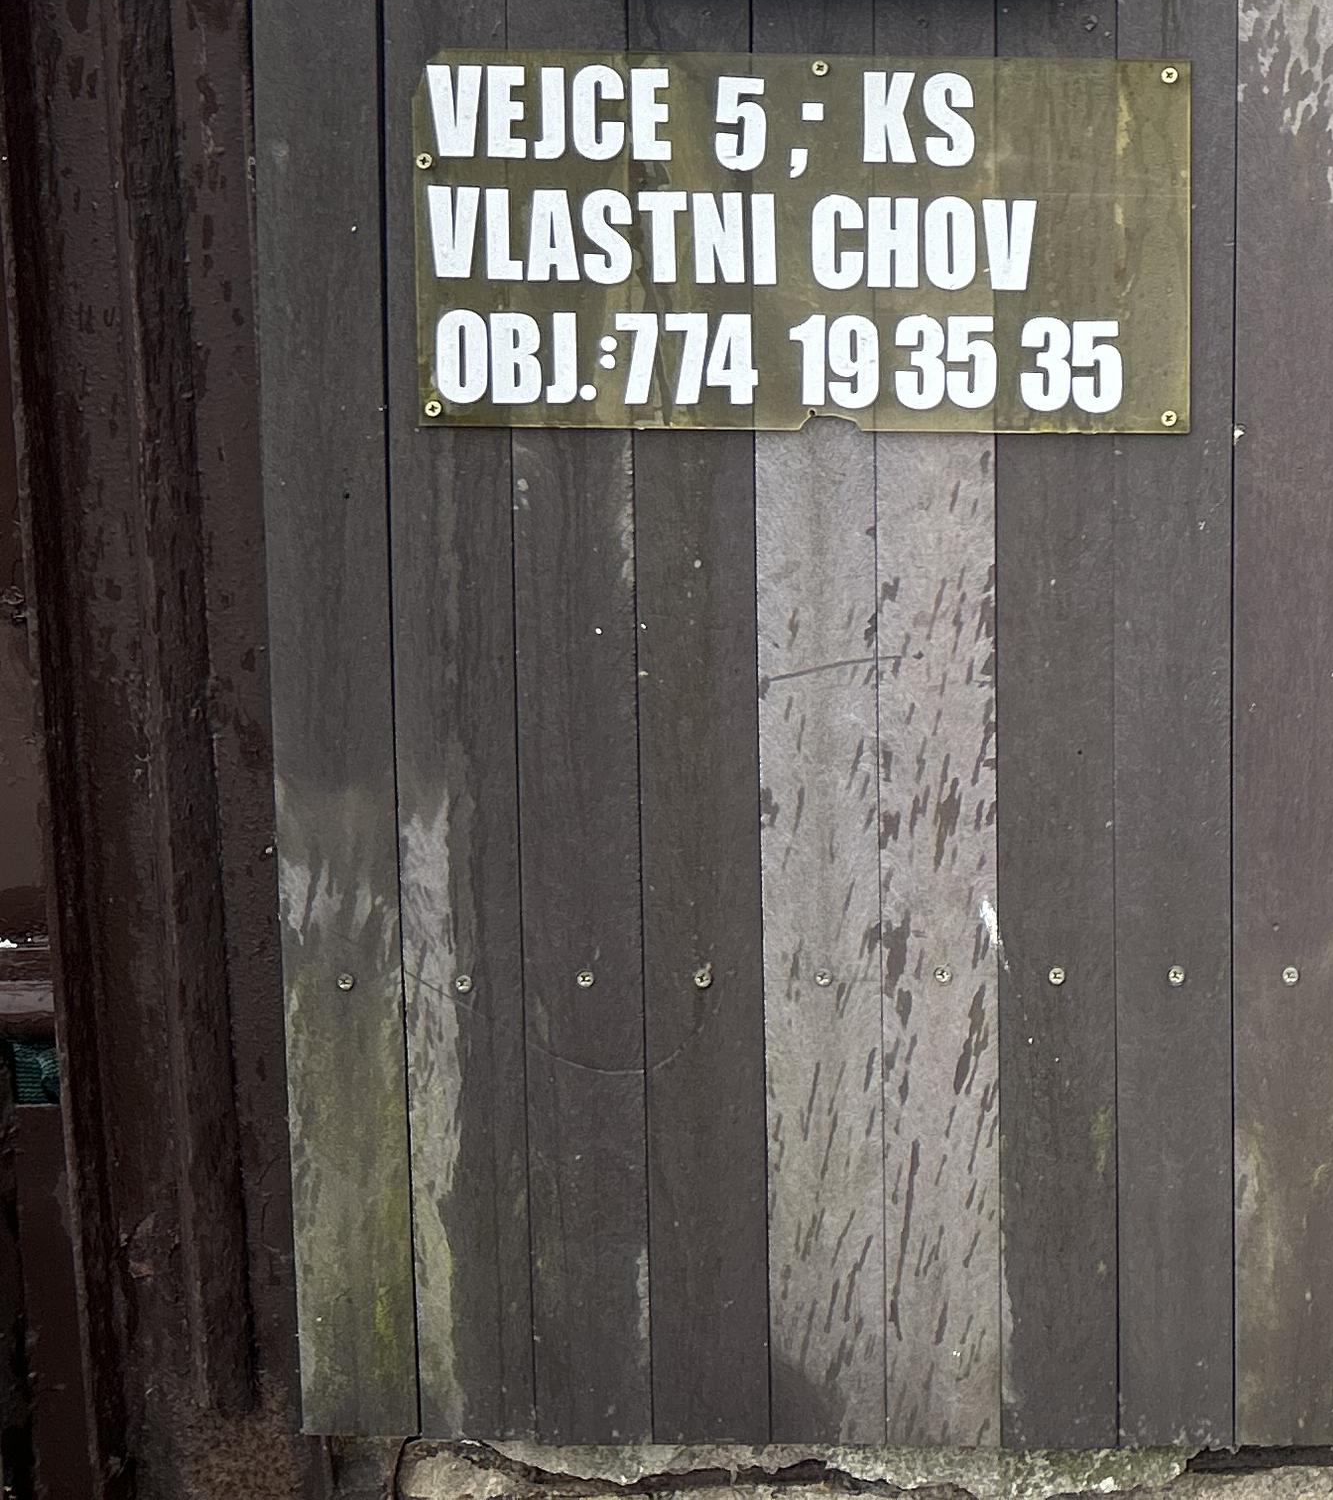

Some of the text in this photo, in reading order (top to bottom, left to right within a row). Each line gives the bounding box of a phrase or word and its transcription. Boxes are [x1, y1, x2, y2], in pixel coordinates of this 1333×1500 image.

[427, 64, 671, 161] VEJCE
[862, 71, 974, 169] KS
[427, 185, 1037, 292] VLASTNI CHOV
[1020, 318, 1123, 414] 35
